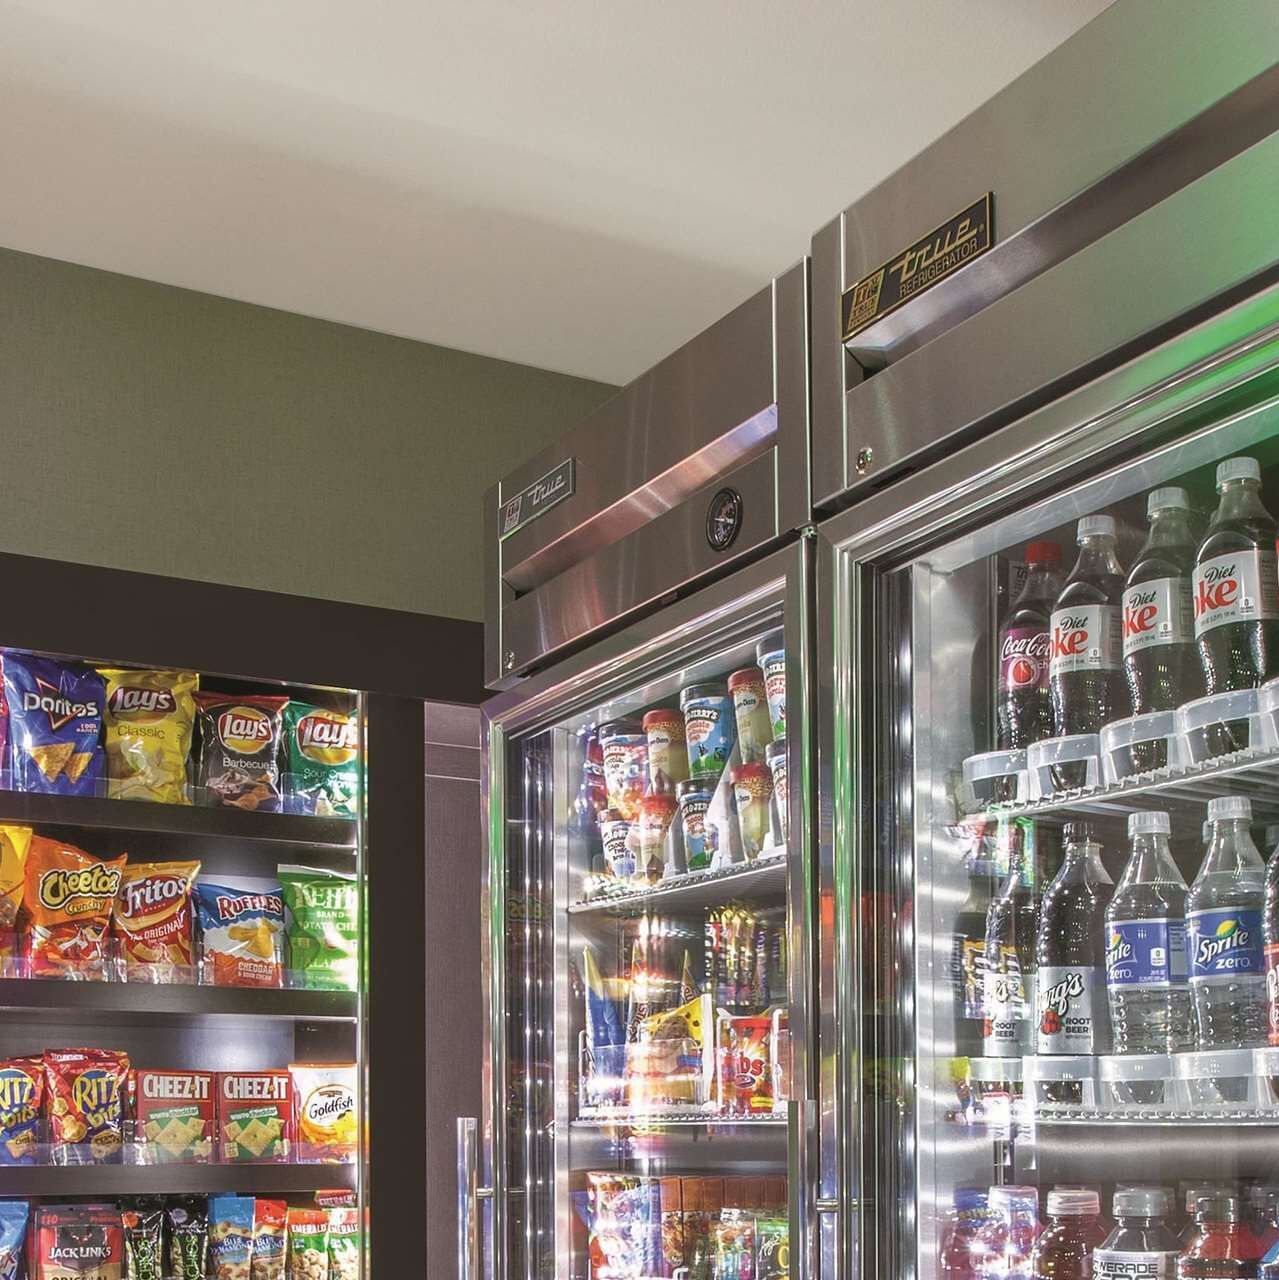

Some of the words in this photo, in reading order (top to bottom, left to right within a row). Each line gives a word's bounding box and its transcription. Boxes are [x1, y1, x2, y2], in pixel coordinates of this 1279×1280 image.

[899, 237, 978, 298] REFRIGERATOR
[1204, 564, 1236, 583] Diet
[1129, 591, 1156, 609] Diet
[1194, 579, 1238, 618] ke
[1060, 616, 1088, 631] Diet
[1122, 605, 1158, 638] ke
[24, 692, 98, 717] Doritos
[113, 687, 172, 713] Lay's
[117, 724, 166, 740] Classic
[223, 714, 269, 739] Lay's
[223, 757, 272, 769] Barbecue
[123, 875, 187, 918] Fritos
[219, 895, 283, 920] RUFFLES
[316, 911, 346, 919] BRAND
[143, 910, 186, 941] ORIGINAL
[1198, 930, 1249, 963] Sprite
[238, 961, 273, 975] CHEDDAR
[1216, 956, 1251, 969] zero
[1109, 968, 1132, 980] zero
[995, 1022, 1016, 1030] ROOT
[1065, 1017, 1091, 1025] ROOT
[1065, 1025, 1089, 1034] BEER
[995, 1030, 1015, 1038] BEER
[76, 1076, 120, 1113] RITZ
[0, 1106, 36, 1126] bits
[309, 1096, 353, 1119] Goldfish
[291, 1223, 327, 1233] EMERALD
[48, 1247, 80, 1259] JACK
